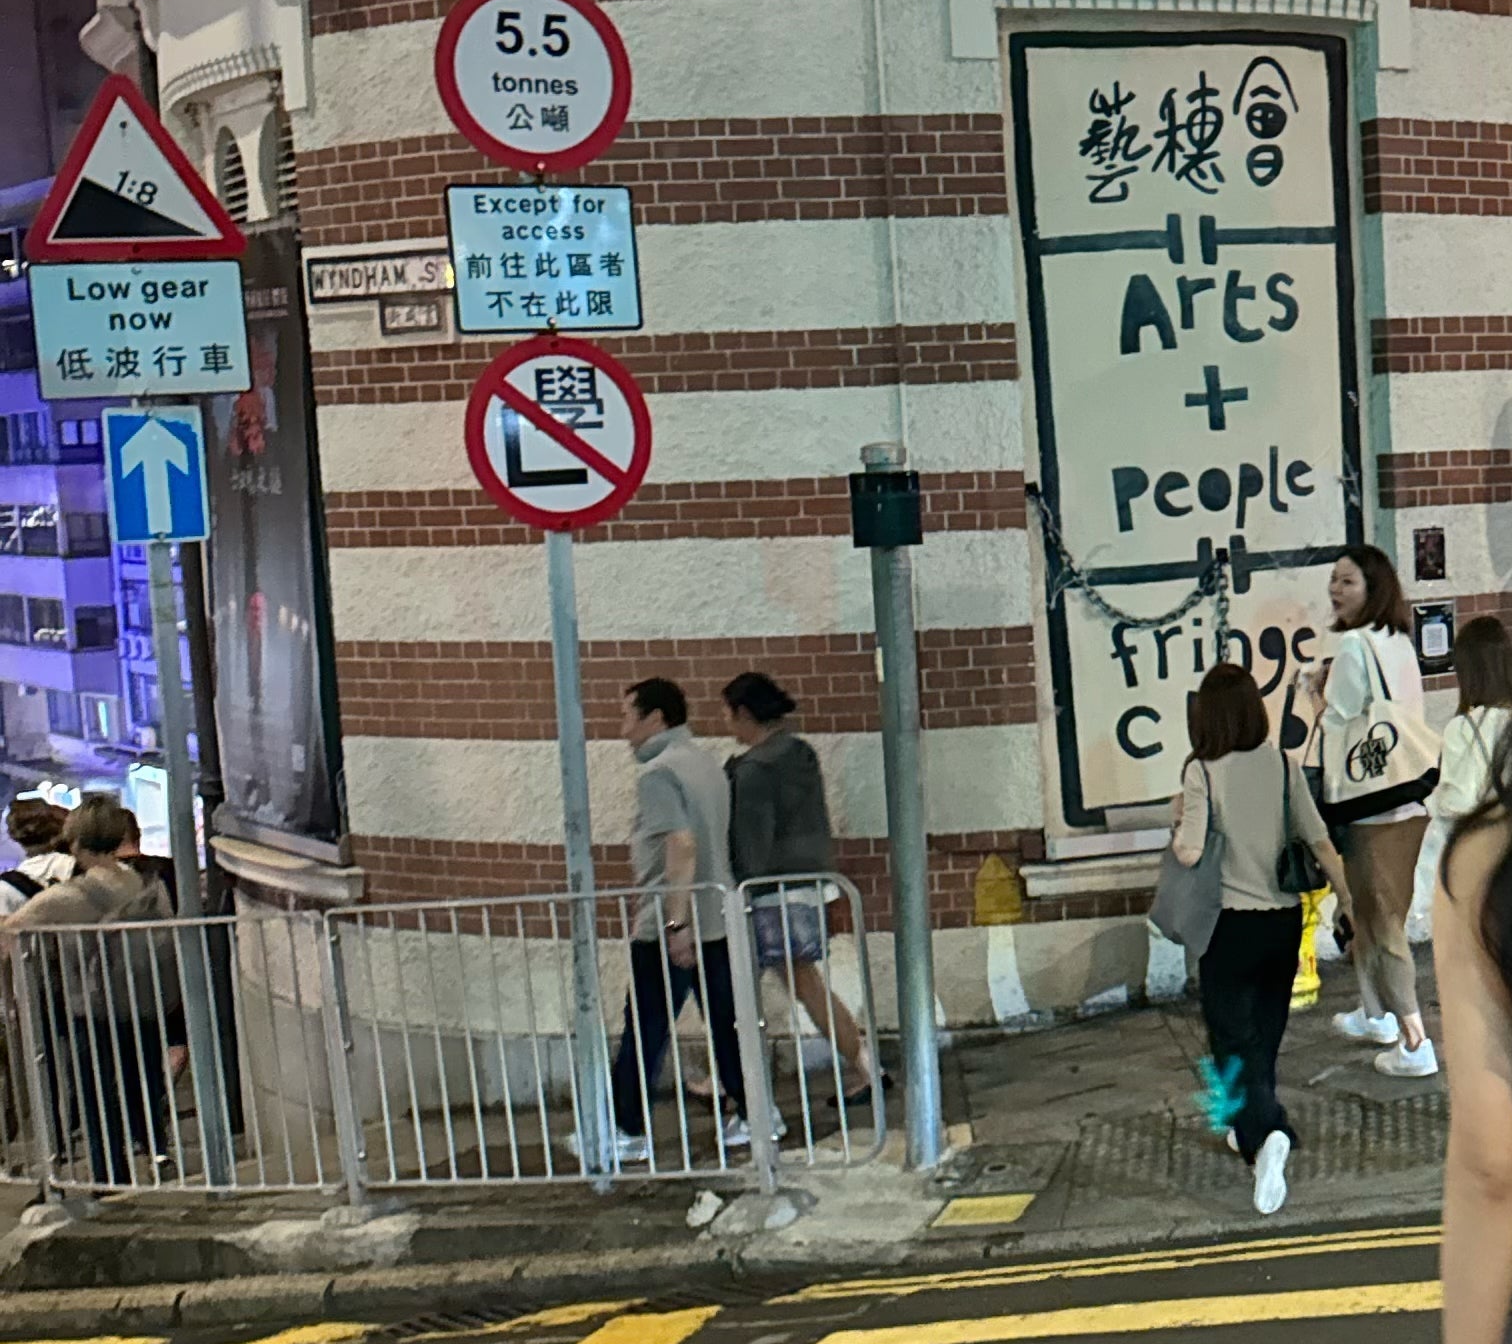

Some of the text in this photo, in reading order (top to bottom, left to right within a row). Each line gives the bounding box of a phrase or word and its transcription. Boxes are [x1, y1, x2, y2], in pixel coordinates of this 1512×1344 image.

[496, 11, 570, 57] 5.5
[492, 72, 578, 95] tonnes
[114, 170, 158, 206] 1:8
[474, 194, 606, 216] Except for
[502, 224, 585, 240] access
[312, 263, 408, 290] WYNDHAM
[466, 251, 625, 279] 前往此區者
[68, 277, 209, 304] Low gear
[485, 290, 614, 318] 不在此限
[109, 311, 172, 331] now
[1120, 270, 1299, 355] Arts
[57, 343, 233, 380] 低波行車
[1111, 618, 1316, 697] fringe
